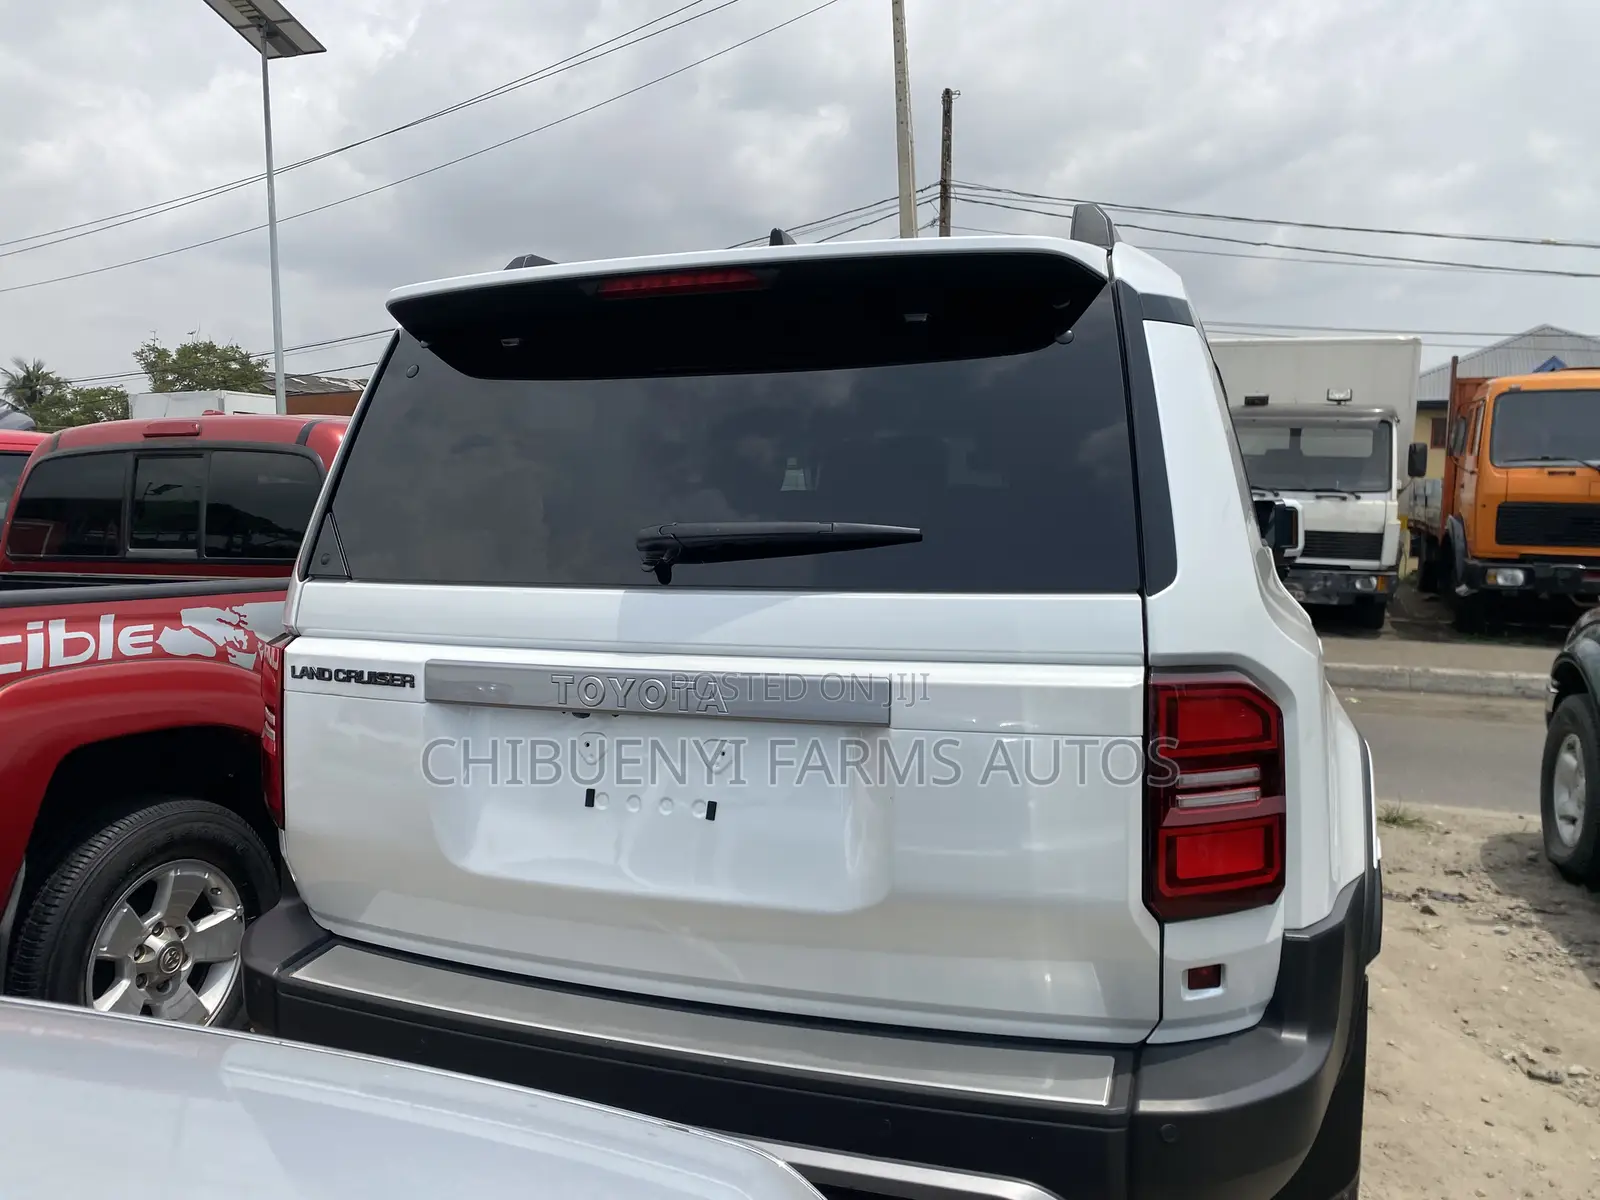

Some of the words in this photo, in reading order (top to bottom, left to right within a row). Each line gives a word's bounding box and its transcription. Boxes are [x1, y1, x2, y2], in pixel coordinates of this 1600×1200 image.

[290, 665, 333, 681] LAND
[333, 668, 416, 689] CRUISER
[550, 673, 730, 714] TOYOTA
